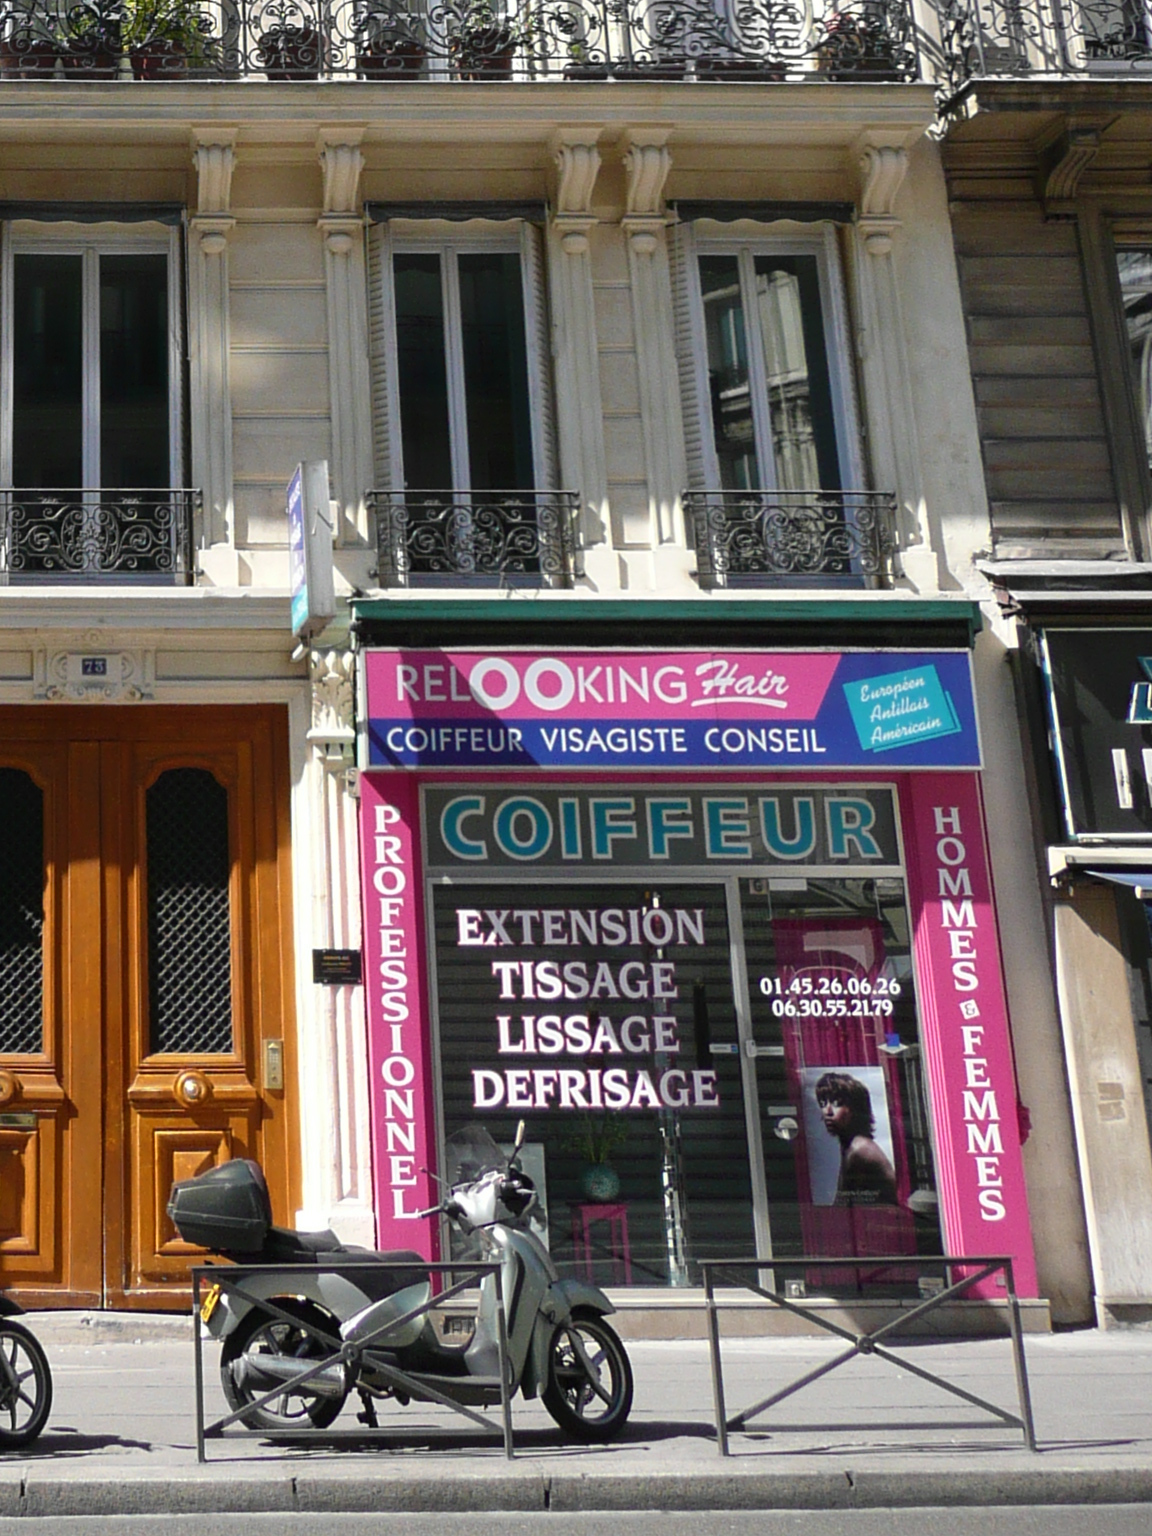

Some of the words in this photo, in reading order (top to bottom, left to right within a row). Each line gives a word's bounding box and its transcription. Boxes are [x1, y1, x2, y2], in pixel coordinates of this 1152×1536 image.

[397, 657, 688, 711] RELOOKING
[695, 659, 789, 697] Hair
[860, 676, 925, 702] Européen
[870, 696, 930, 723] Antillais
[386, 727, 524, 752] COIFFEUR
[540, 727, 688, 752] VISAGISTE
[704, 727, 827, 753] CONSEIL
[871, 716, 942, 744] Américain
[440, 794, 884, 861] COIFFEUR
[456, 909, 705, 946] EXTENSION
[492, 961, 678, 999] TISSAGE
[760, 977, 901, 995] 01.45.26.06.26
[373, 804, 419, 1220] PROFESSIONNEL
[772, 999, 893, 1017] 06.30.55.21.79
[933, 806, 979, 992] HOMMES
[961, 1025, 1006, 1222] FEMMES
[496, 1015, 680, 1053] LISSAGE
[471, 1069, 719, 1108] DEFRISAGE
